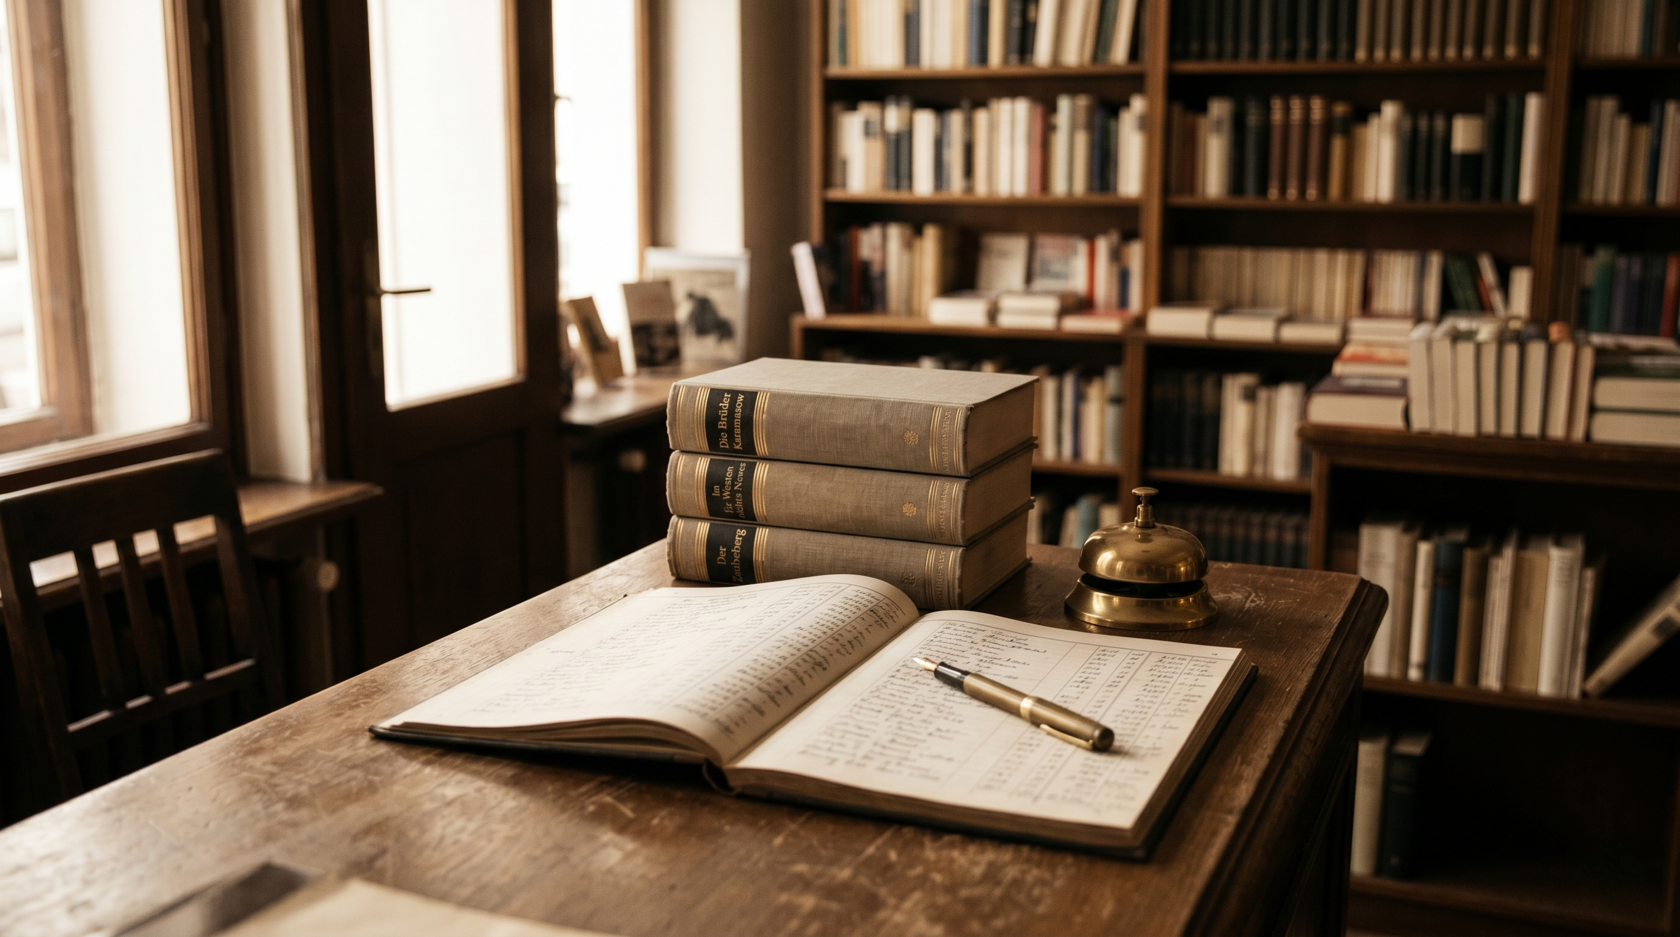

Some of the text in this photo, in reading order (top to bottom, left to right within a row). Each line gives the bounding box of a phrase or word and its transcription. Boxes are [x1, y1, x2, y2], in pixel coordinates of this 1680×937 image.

[718, 392, 732, 449] Die Brüder
[733, 393, 745, 451] Karamasow
[711, 485, 721, 497] Im
[722, 466, 734, 500] Westen
[716, 545, 727, 565] Der
